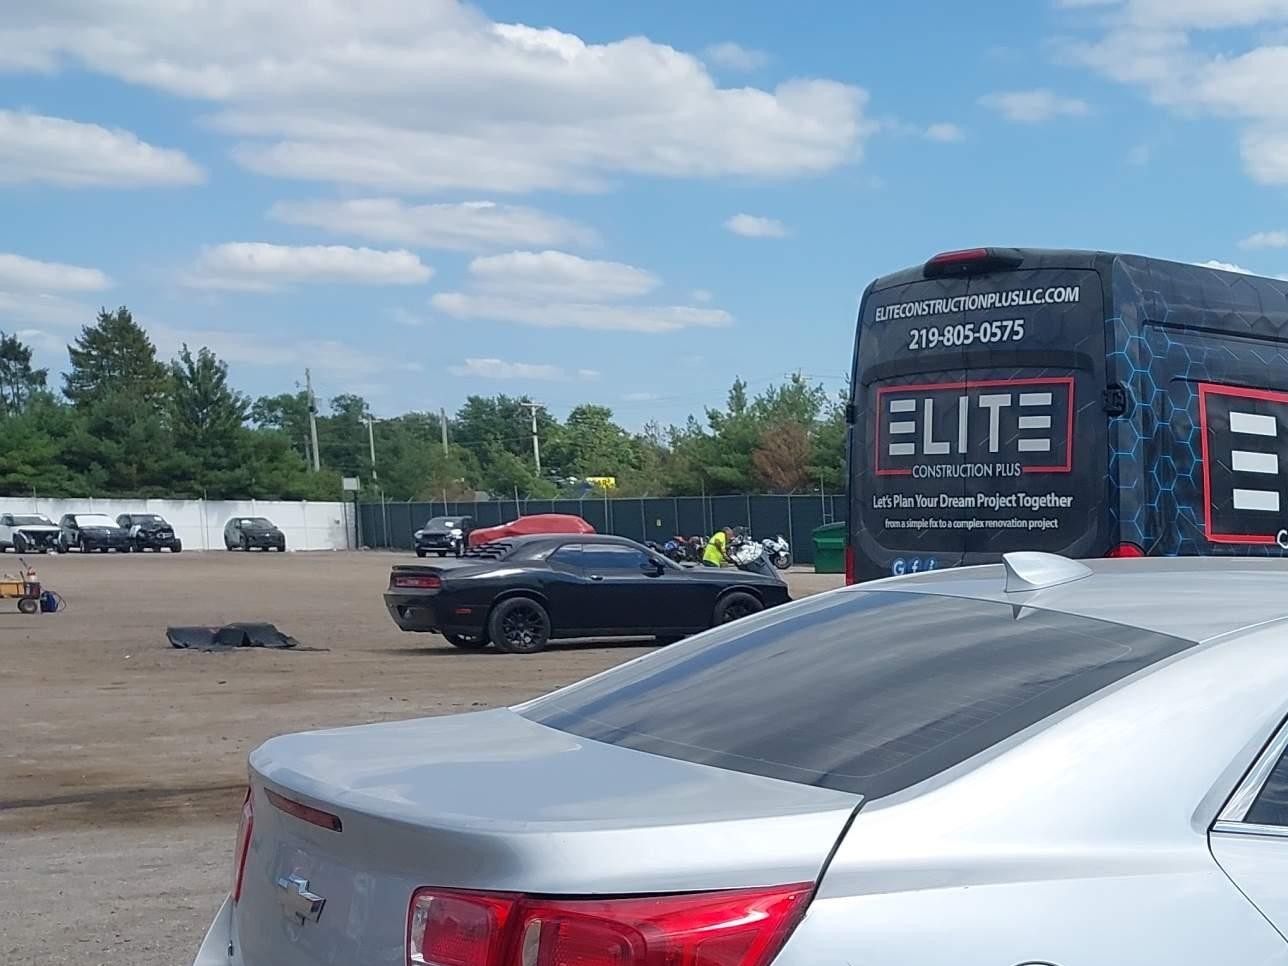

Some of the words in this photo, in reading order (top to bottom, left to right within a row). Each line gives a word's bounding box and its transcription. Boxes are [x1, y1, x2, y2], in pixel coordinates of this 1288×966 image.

[875, 286, 1079, 321] ELITECONSTRUCTIONPLUSLLC.COM
[909, 319, 1025, 350] 219-805-0575
[889, 392, 1053, 456] ELITE
[912, 464, 993, 478] CONSTRUCTION
[996, 463, 1021, 477] PLUS
[873, 495, 892, 508] Let's
[893, 495, 914, 508] Plan
[915, 495, 938, 508] Your
[939, 494, 975, 508] Dream
[977, 493, 1016, 510] Project
[1017, 492, 1073, 510] Together
[885, 519, 900, 528] from
[906, 519, 928, 530] simple
[929, 519, 938, 528] fix
[938, 519, 946, 528] to
[953, 518, 984, 530] complex
[985, 517, 1027, 528] renovation
[1028, 518, 1058, 530] project
